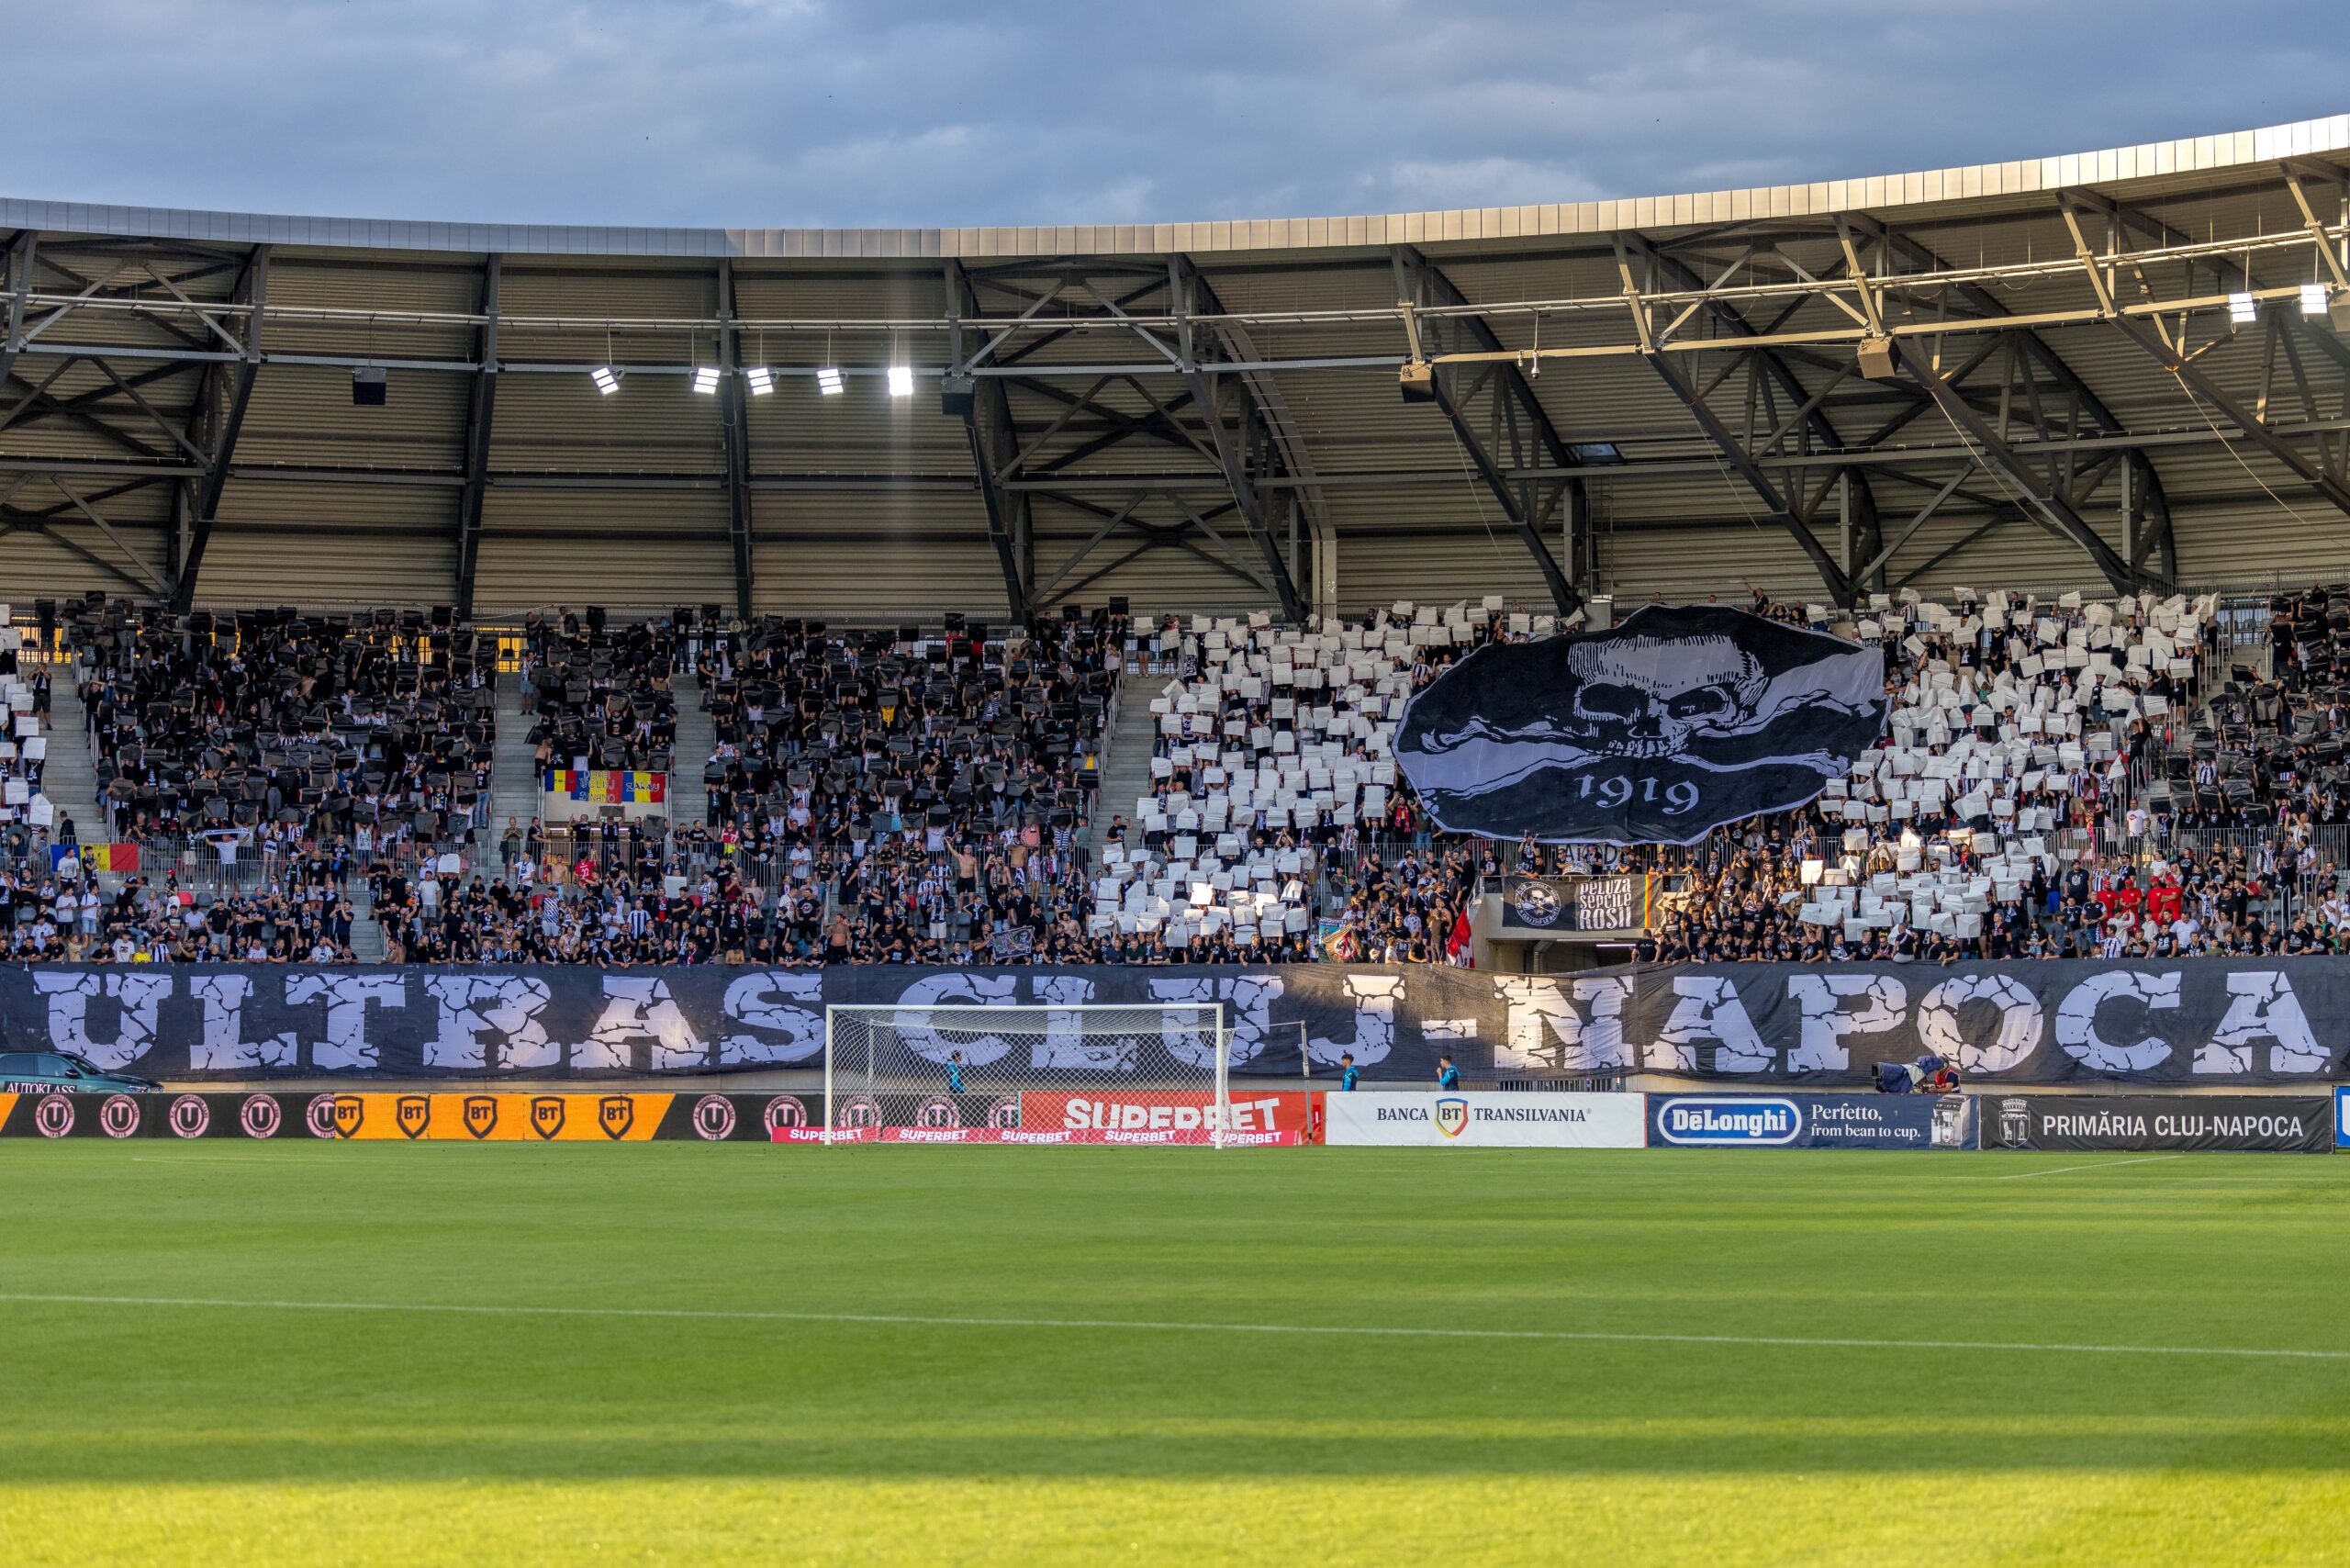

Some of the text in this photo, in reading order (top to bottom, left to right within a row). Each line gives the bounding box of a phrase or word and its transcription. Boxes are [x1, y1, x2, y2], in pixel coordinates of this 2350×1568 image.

[1572, 774, 1699, 815] 1919
[33, 970, 2332, 1074] ULTRAS CLUJ-NAPOCA
[6, 1082, 75, 1093] AUTOKLASS
[338, 1106, 356, 1119] BT
[404, 1106, 423, 1119] BT
[471, 1106, 491, 1119] BT
[538, 1106, 558, 1120] BT
[607, 1106, 626, 1120] BT
[1063, 1098, 1280, 1131] SUPERBET
[1377, 1108, 1429, 1121] BANCA
[1441, 1108, 1461, 1121] BT
[1811, 1103, 1883, 1121] Perfetto,
[2042, 1110, 2304, 1137] PRIMĂRIA CLUJ-NAPOCA
[789, 1128, 863, 1141] SUPERBET
[900, 1128, 968, 1141] SUPERBET
[1001, 1130, 1071, 1143] SUPERBET
[1104, 1130, 1176, 1143] SUPERBET
[1209, 1131, 1281, 1144] SUPERBET
[1811, 1124, 1921, 1139] from bean to cup.
